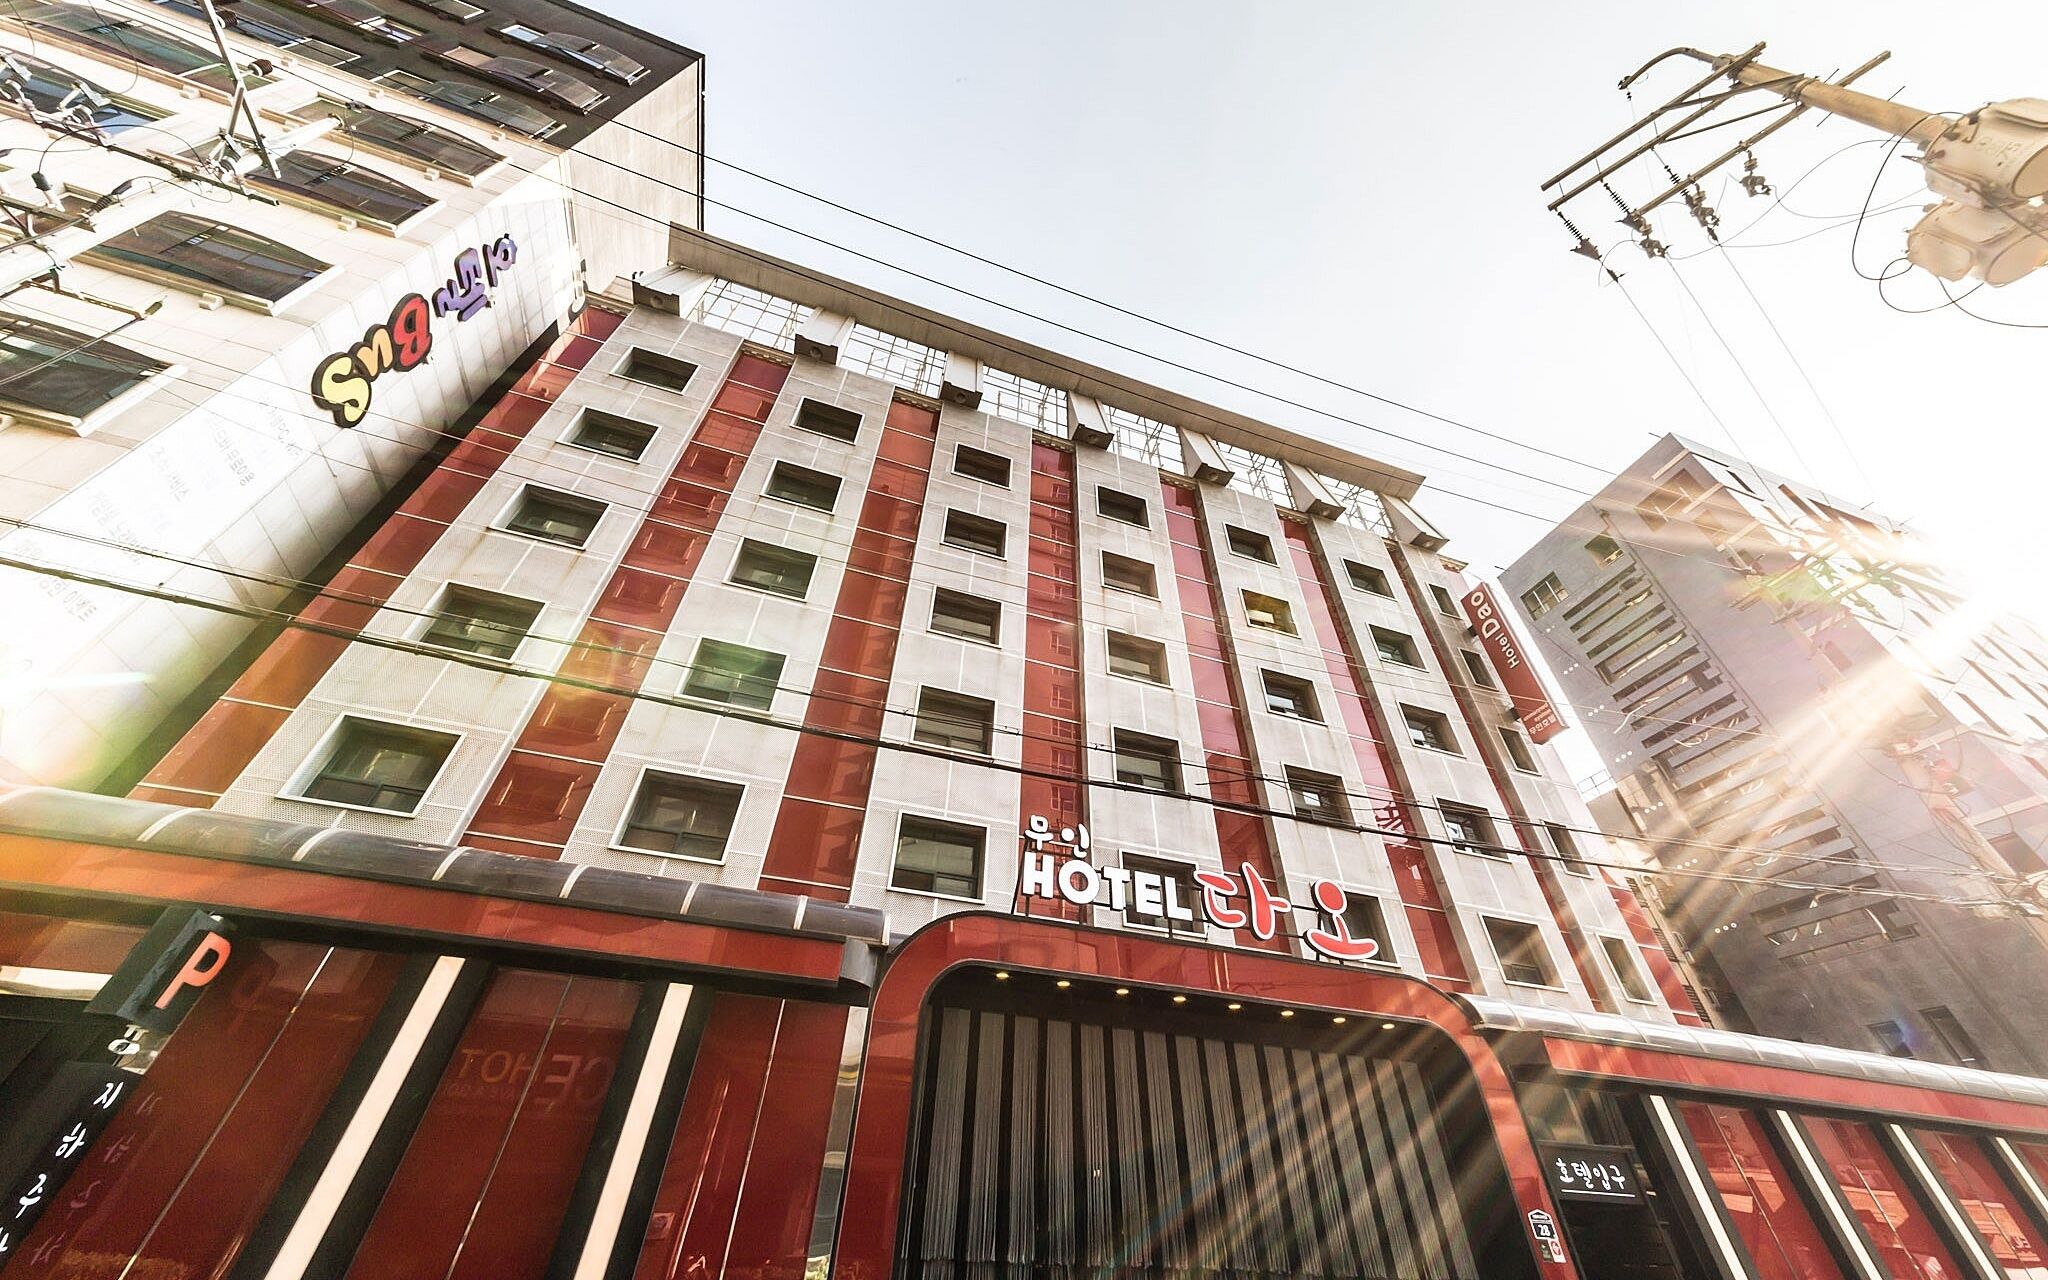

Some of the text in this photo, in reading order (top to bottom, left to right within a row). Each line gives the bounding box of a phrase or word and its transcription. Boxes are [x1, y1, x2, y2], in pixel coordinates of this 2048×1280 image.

[1495, 632, 1520, 669] Hotel
[1024, 814, 1090, 858] 무인
[1022, 852, 1379, 961] HOTEL 다오
[155, 931, 231, 1010] P
[1556, 1157, 1626, 1191] 호텔입구
[1537, 1224, 1551, 1236] 28
